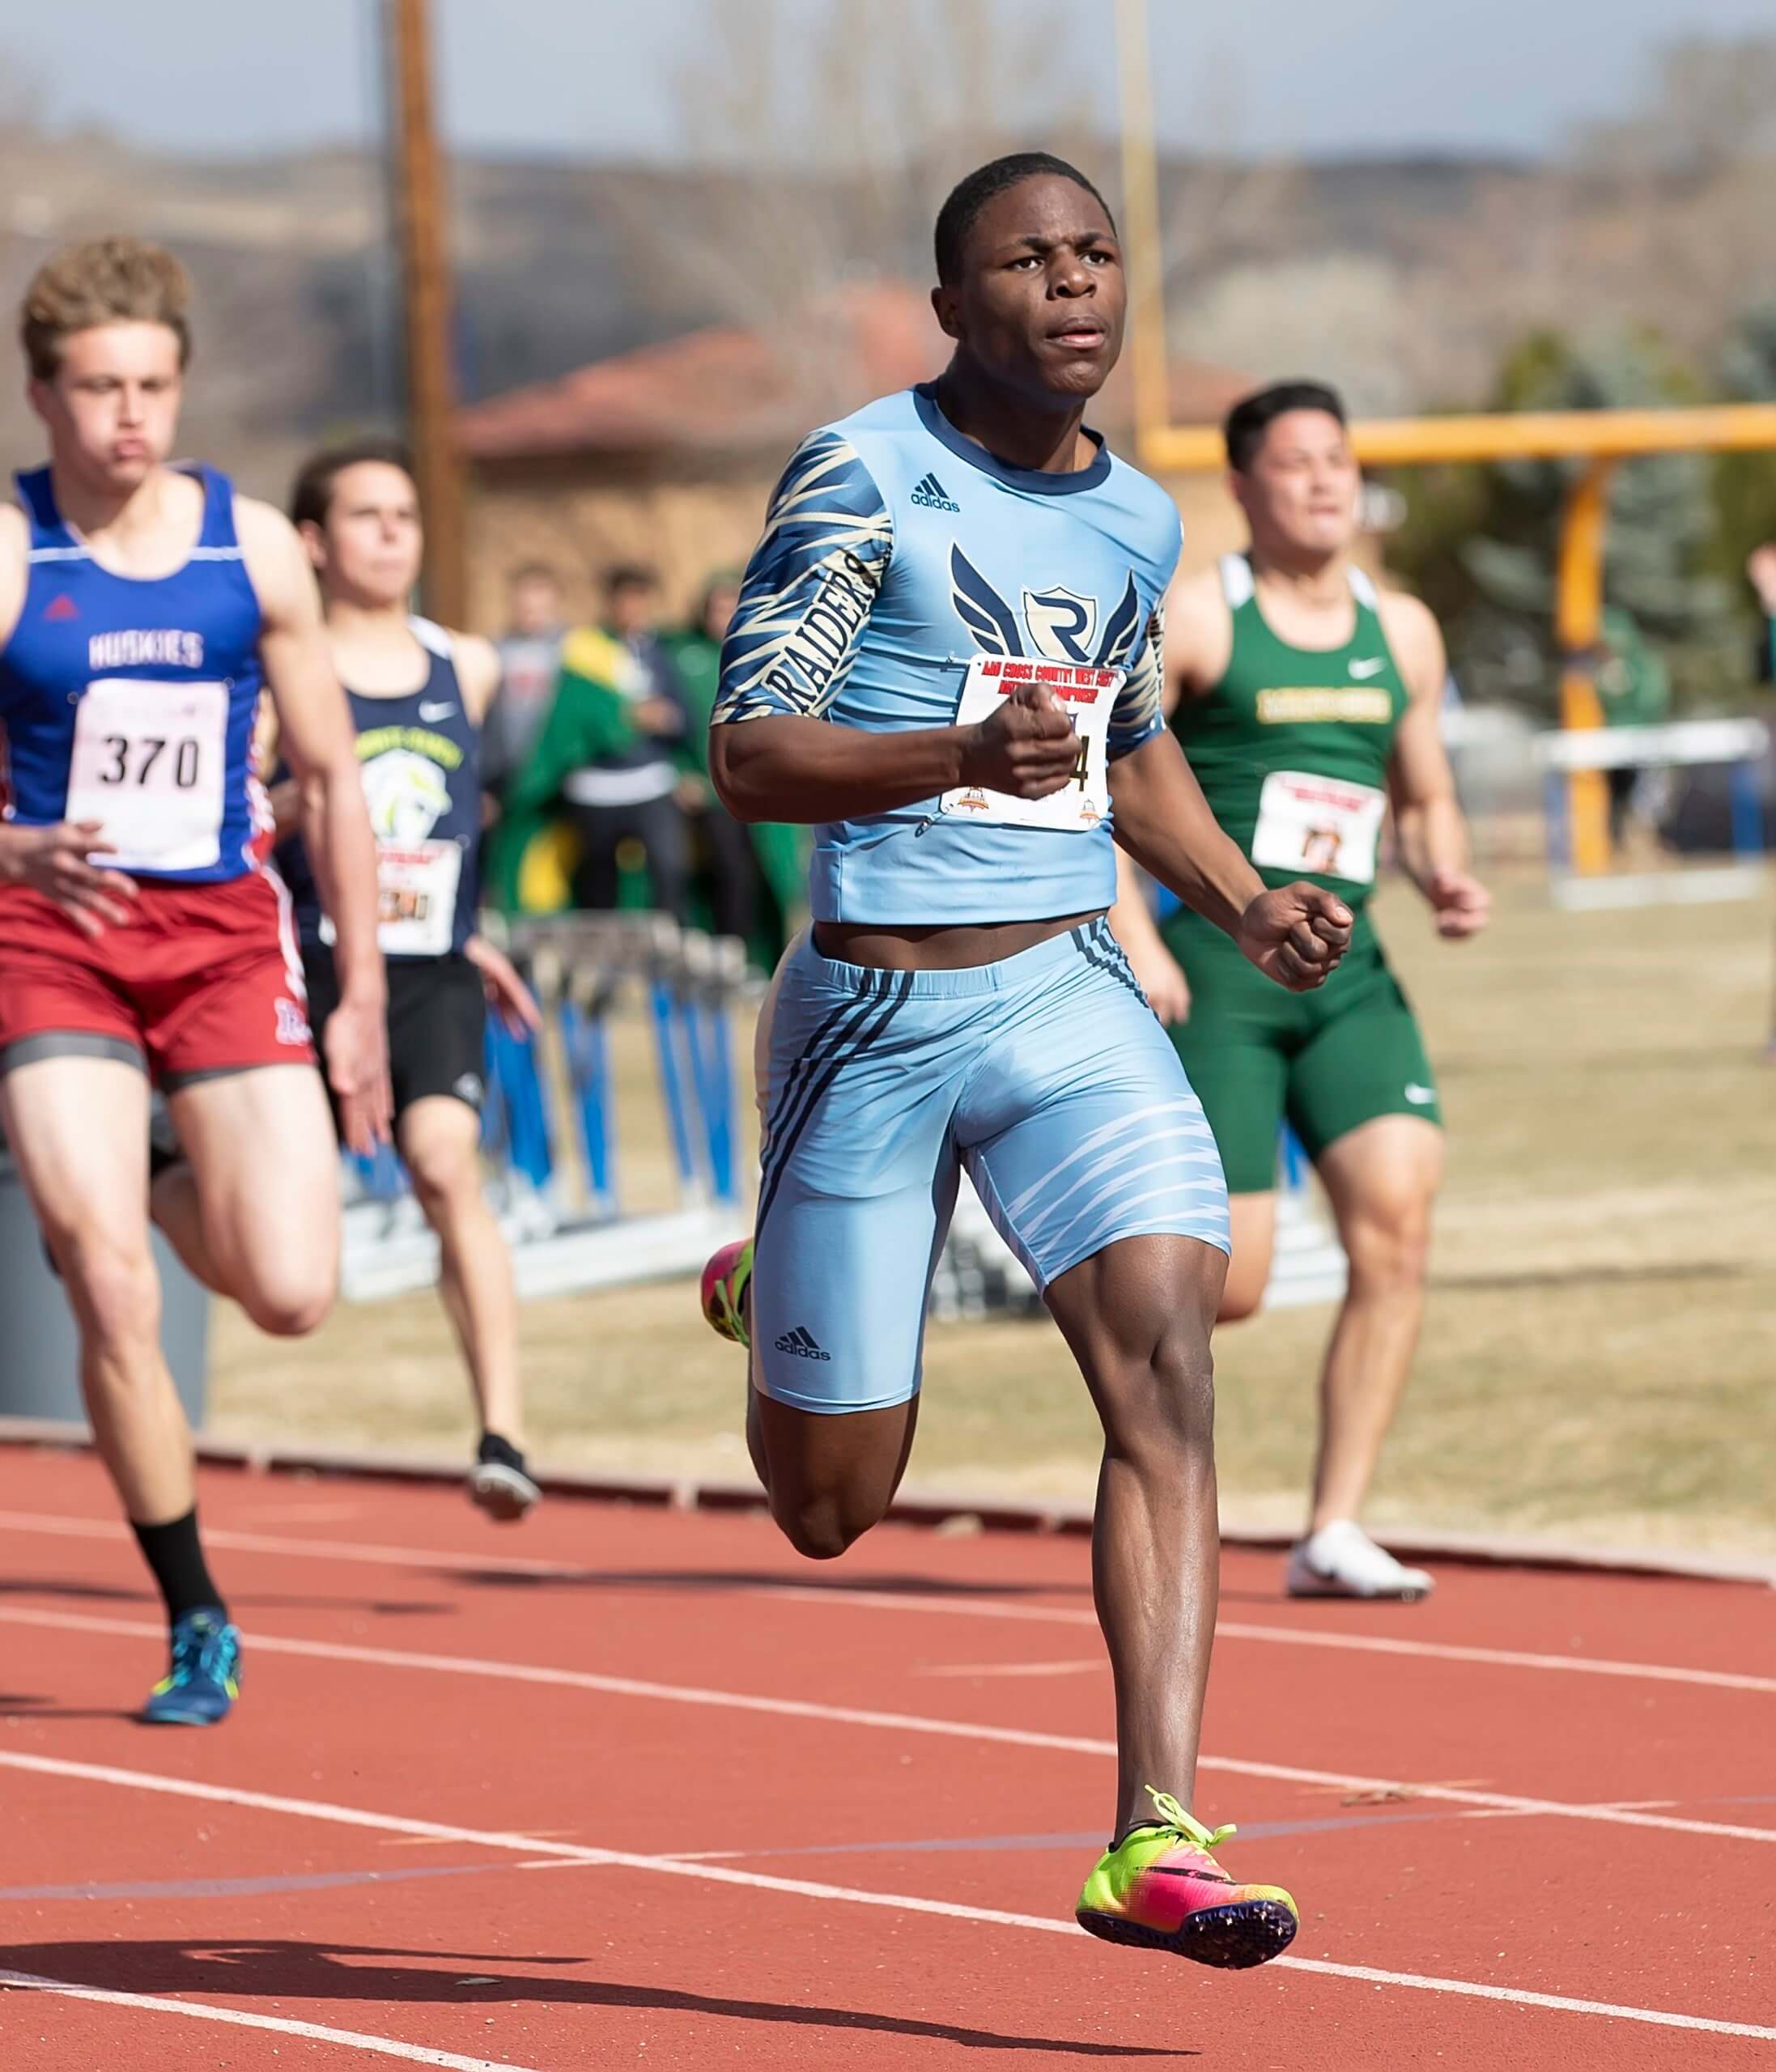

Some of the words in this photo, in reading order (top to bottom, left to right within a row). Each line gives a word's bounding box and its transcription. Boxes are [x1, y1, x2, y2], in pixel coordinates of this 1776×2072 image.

[911, 493, 960, 512] adidas
[765, 551, 880, 715] RAIDERS
[89, 629, 204, 671] HUSKIES
[1003, 663, 1034, 680] CROSS
[100, 732, 201, 788] 370
[774, 1340, 831, 1361] adidas
